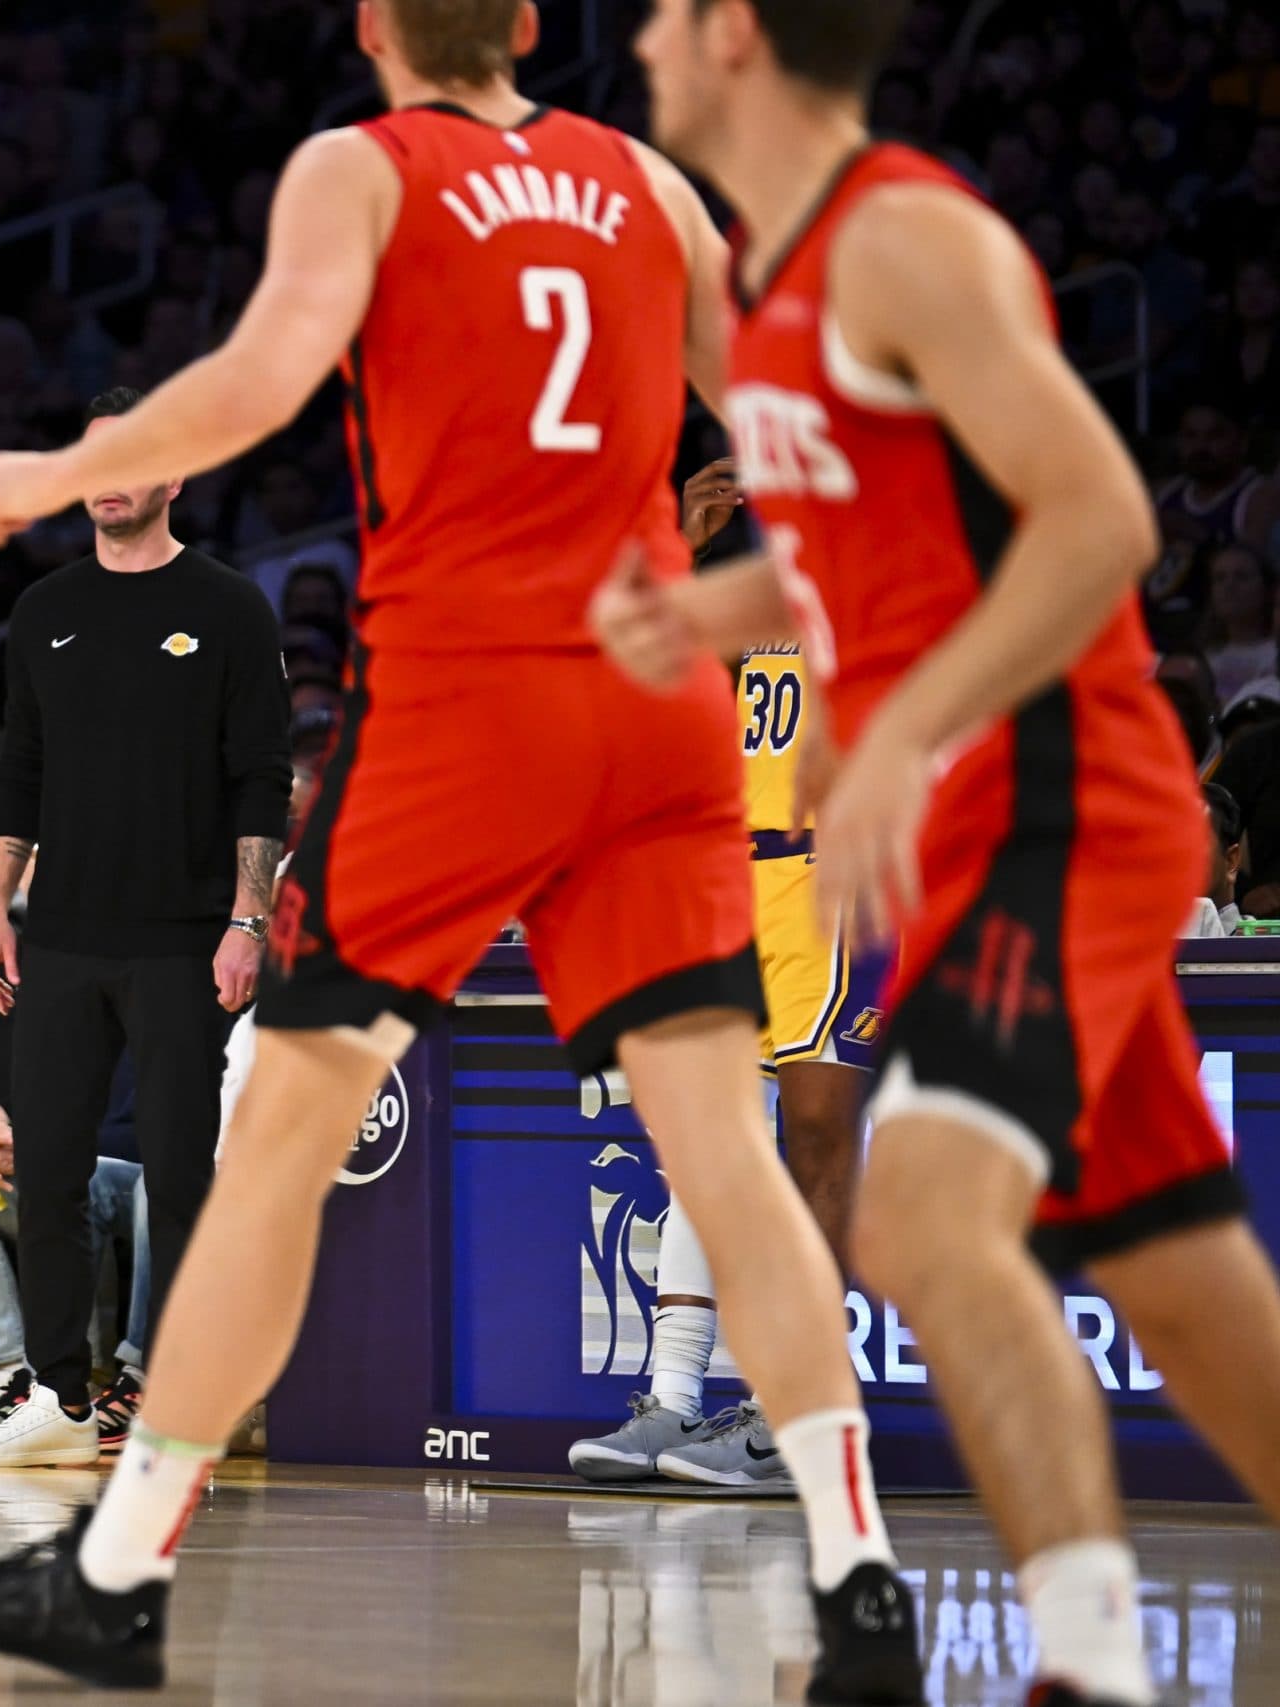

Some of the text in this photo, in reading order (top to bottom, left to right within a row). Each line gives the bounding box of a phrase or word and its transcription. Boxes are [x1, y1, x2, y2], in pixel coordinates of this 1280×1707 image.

[440, 163, 631, 245] LANDALE
[521, 266, 602, 452] 2
[743, 670, 802, 756] 30
[424, 1427, 490, 1461] anc
